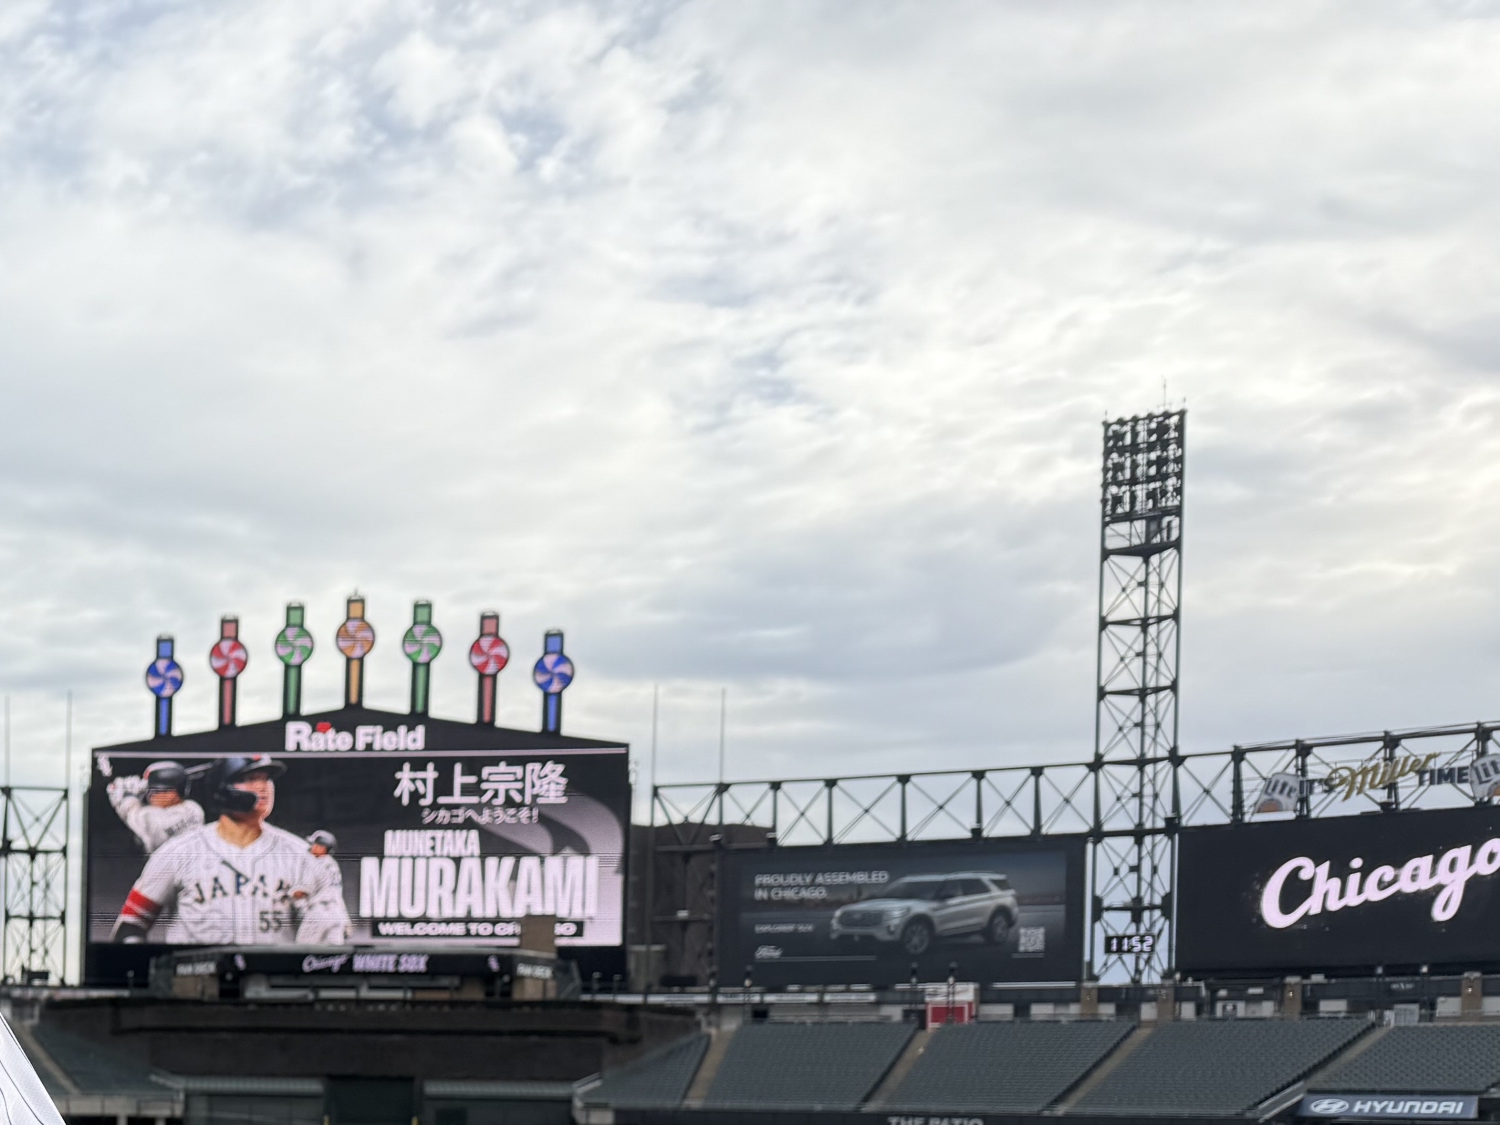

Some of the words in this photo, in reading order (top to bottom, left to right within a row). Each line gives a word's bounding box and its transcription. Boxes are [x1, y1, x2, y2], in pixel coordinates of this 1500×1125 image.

[285, 721, 354, 751] Rate
[355, 724, 425, 751] Field
[393, 760, 568, 806] 村上宗隆
[1264, 777, 1297, 799] Lite
[1325, 752, 1440, 802] Miller
[1418, 765, 1470, 787] TIME
[384, 829, 480, 857] MUNETAKA
[359, 854, 598, 918] MURAKAMI
[754, 873, 814, 887] PROUDLY
[815, 870, 889, 885] ASSEMBLED
[1261, 838, 1500, 929] Chicago
[754, 887, 768, 900] IN
[259, 911, 282, 933] 55
[378, 922, 466, 936] WELCOME
[469, 922, 492, 936] TO
[352, 953, 397, 973] WHITE
[398, 953, 428, 973] SOX
[1352, 1098, 1465, 1116] HYUNDAI
